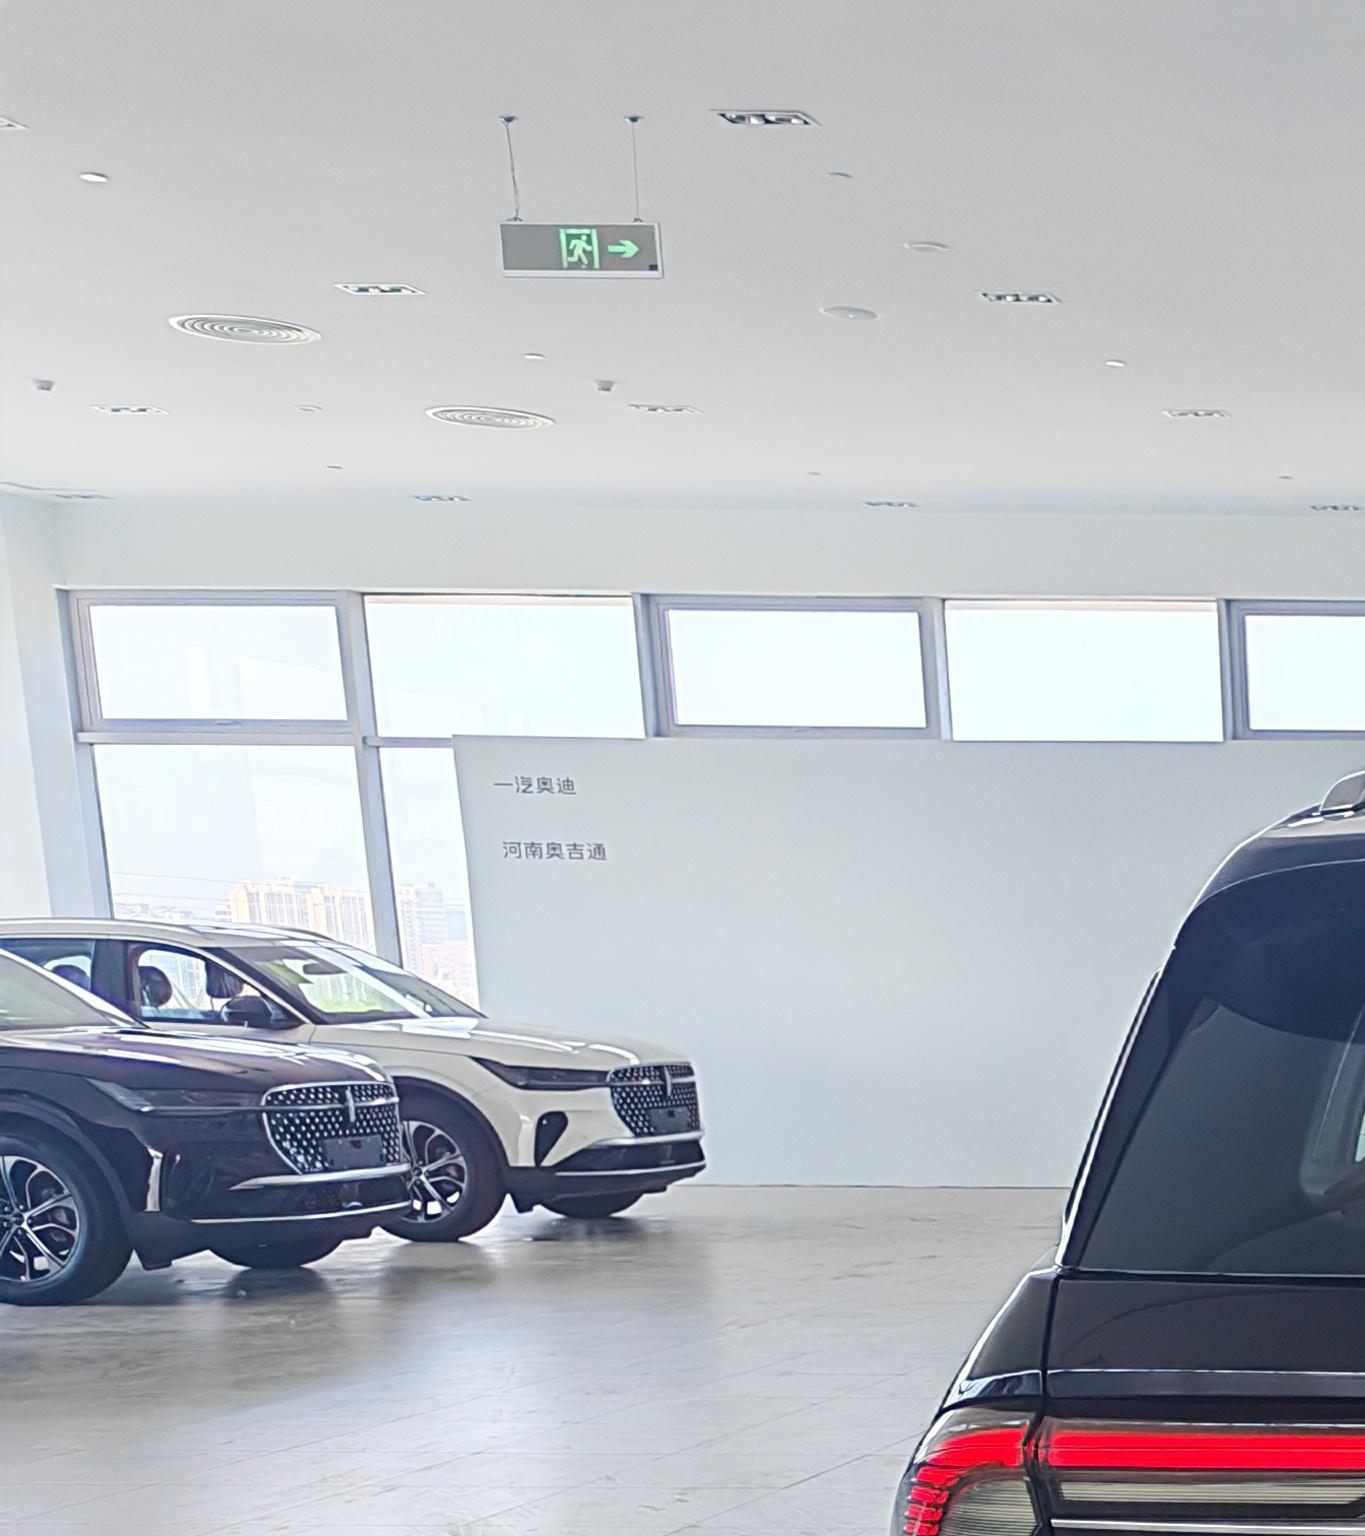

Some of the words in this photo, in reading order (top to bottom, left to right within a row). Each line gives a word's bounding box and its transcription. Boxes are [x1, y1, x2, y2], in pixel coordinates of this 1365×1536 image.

[494, 776, 577, 795] 一汽奥迪
[503, 841, 607, 861] 河南奥吉通
